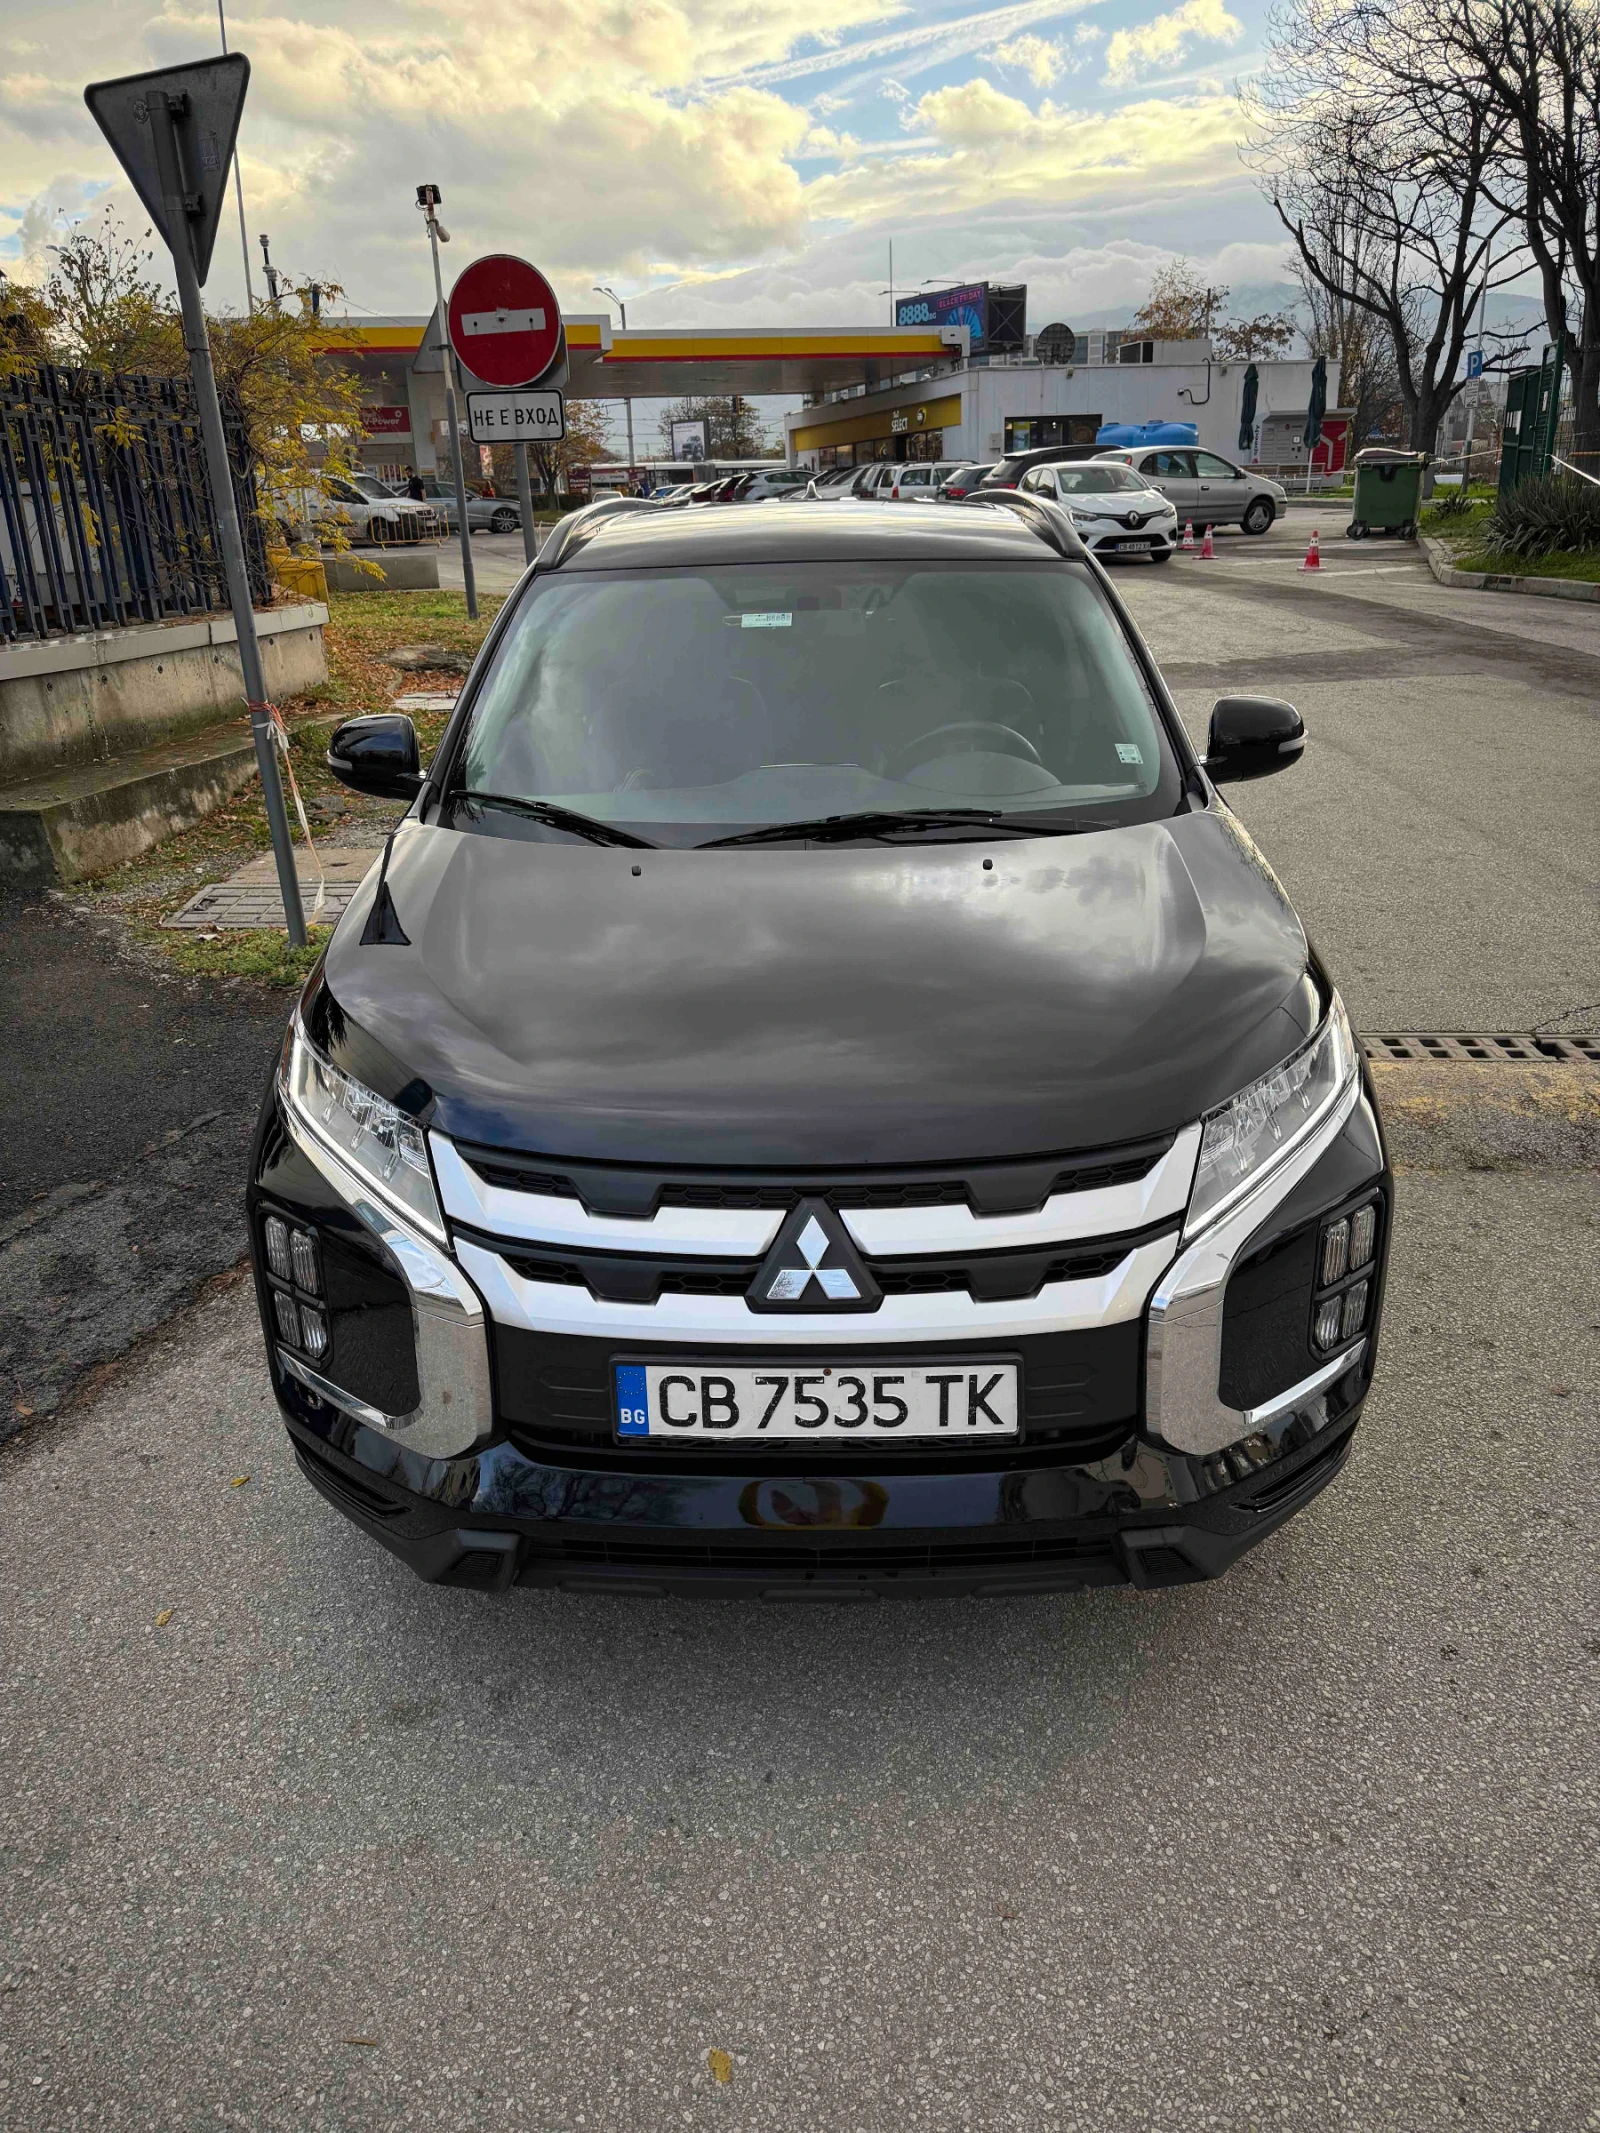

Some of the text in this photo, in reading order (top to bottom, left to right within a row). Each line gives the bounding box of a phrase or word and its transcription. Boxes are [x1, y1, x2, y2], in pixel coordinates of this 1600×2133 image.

[939, 289, 982, 309] BLACK FRIDAY
[1470, 354, 1480, 376] P
[362, 416, 400, 426] V-Power
[473, 407, 559, 427] НЕ Е ВХОД
[891, 417, 908, 433] SELECT
[1253, 424, 1261, 456] speedy
[659, 1373, 1005, 1429] CB 7535 TK
[620, 1408, 646, 1425] BG
